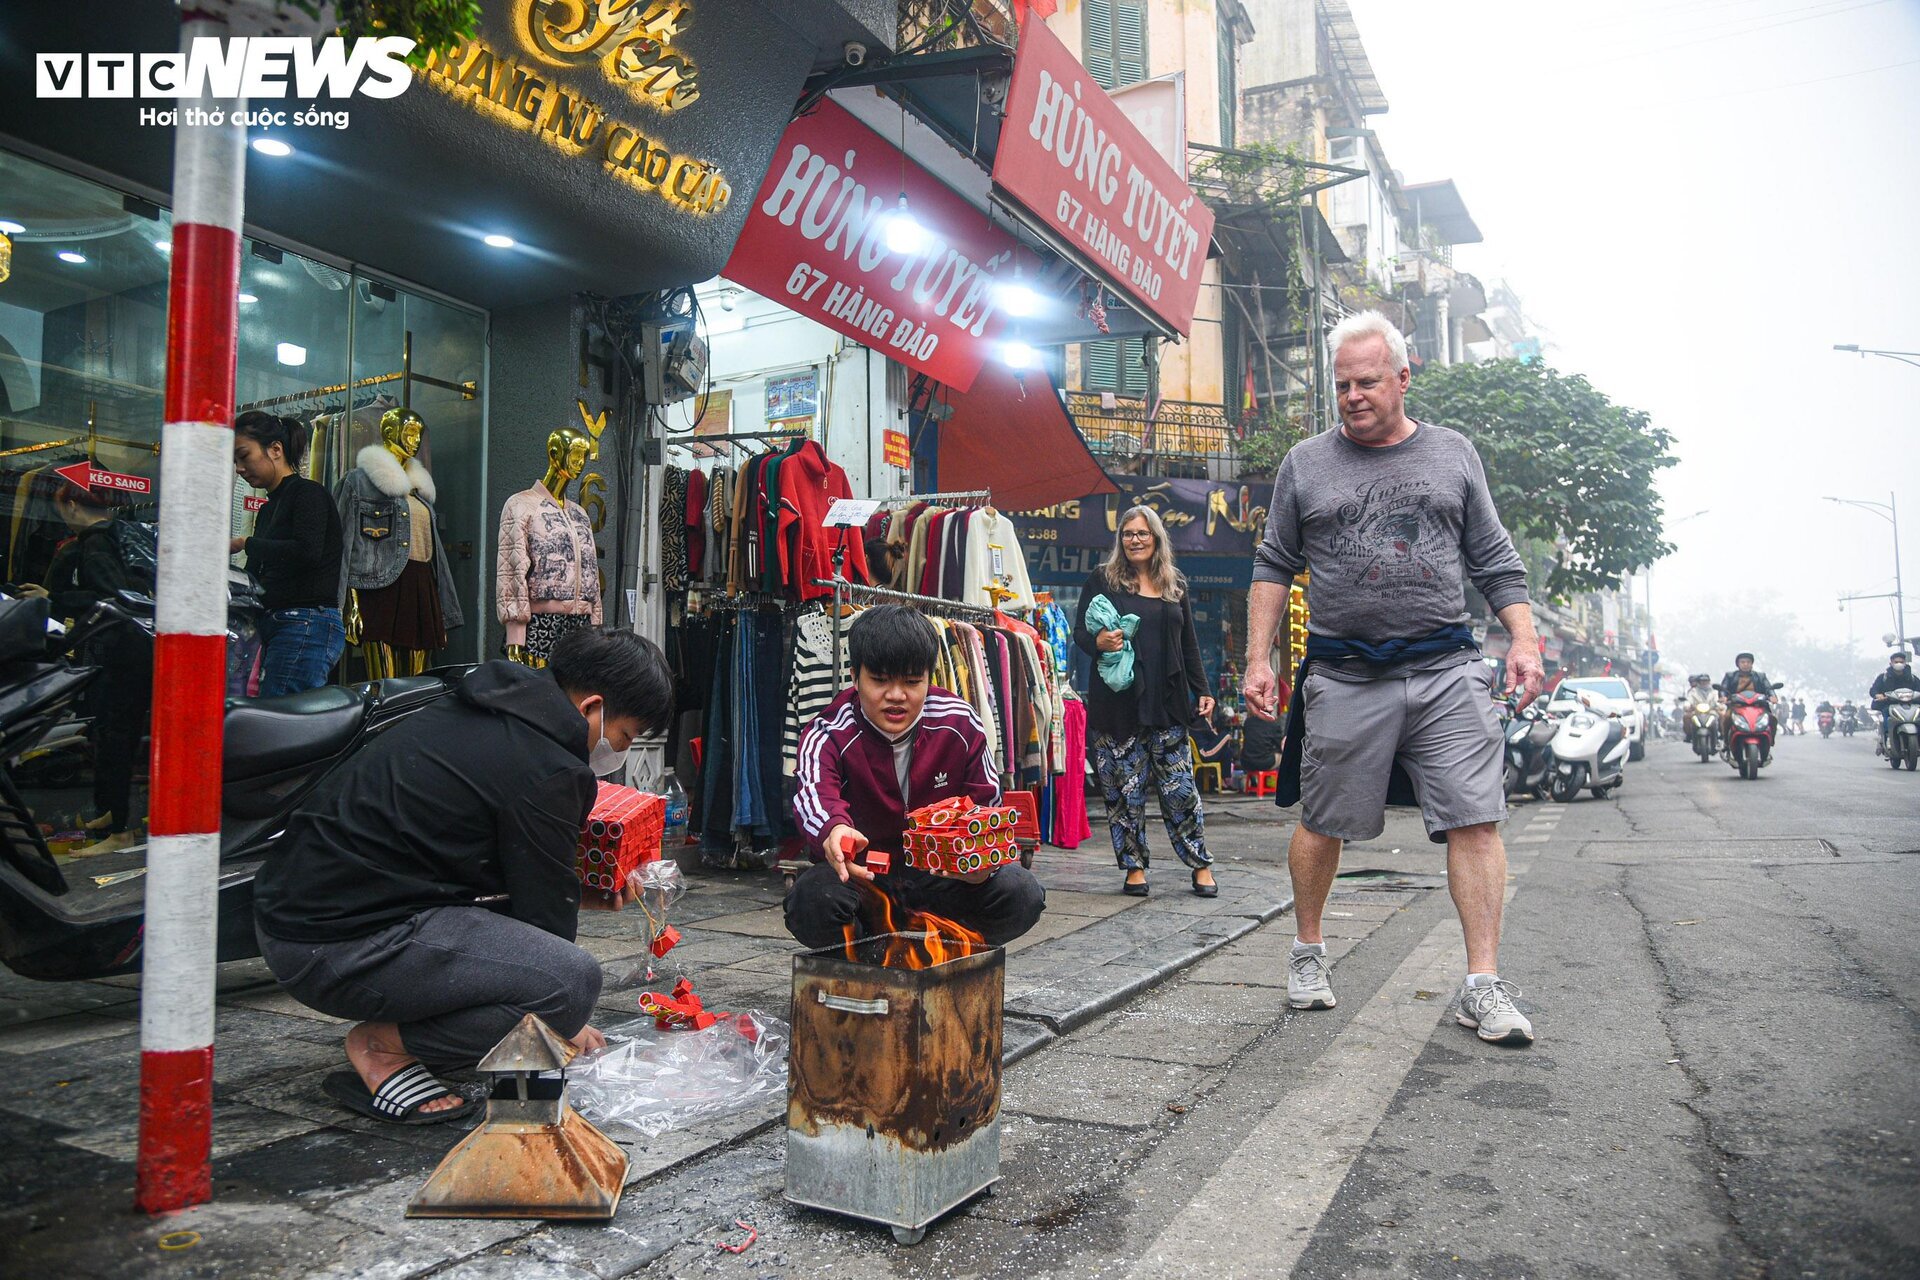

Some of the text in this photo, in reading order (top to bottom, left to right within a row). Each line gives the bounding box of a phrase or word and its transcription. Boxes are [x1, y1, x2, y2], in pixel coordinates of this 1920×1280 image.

[428, 38, 547, 121] RANG
[607, 126, 672, 186] CAO
[1056, 190, 1162, 301] 67 HÀNG ĐÀO
[1122, 164, 1199, 281] TUYẾT
[785, 262, 940, 362] 67 HÀNG ĐÀO
[90, 471, 146, 490] KÉO SANG
